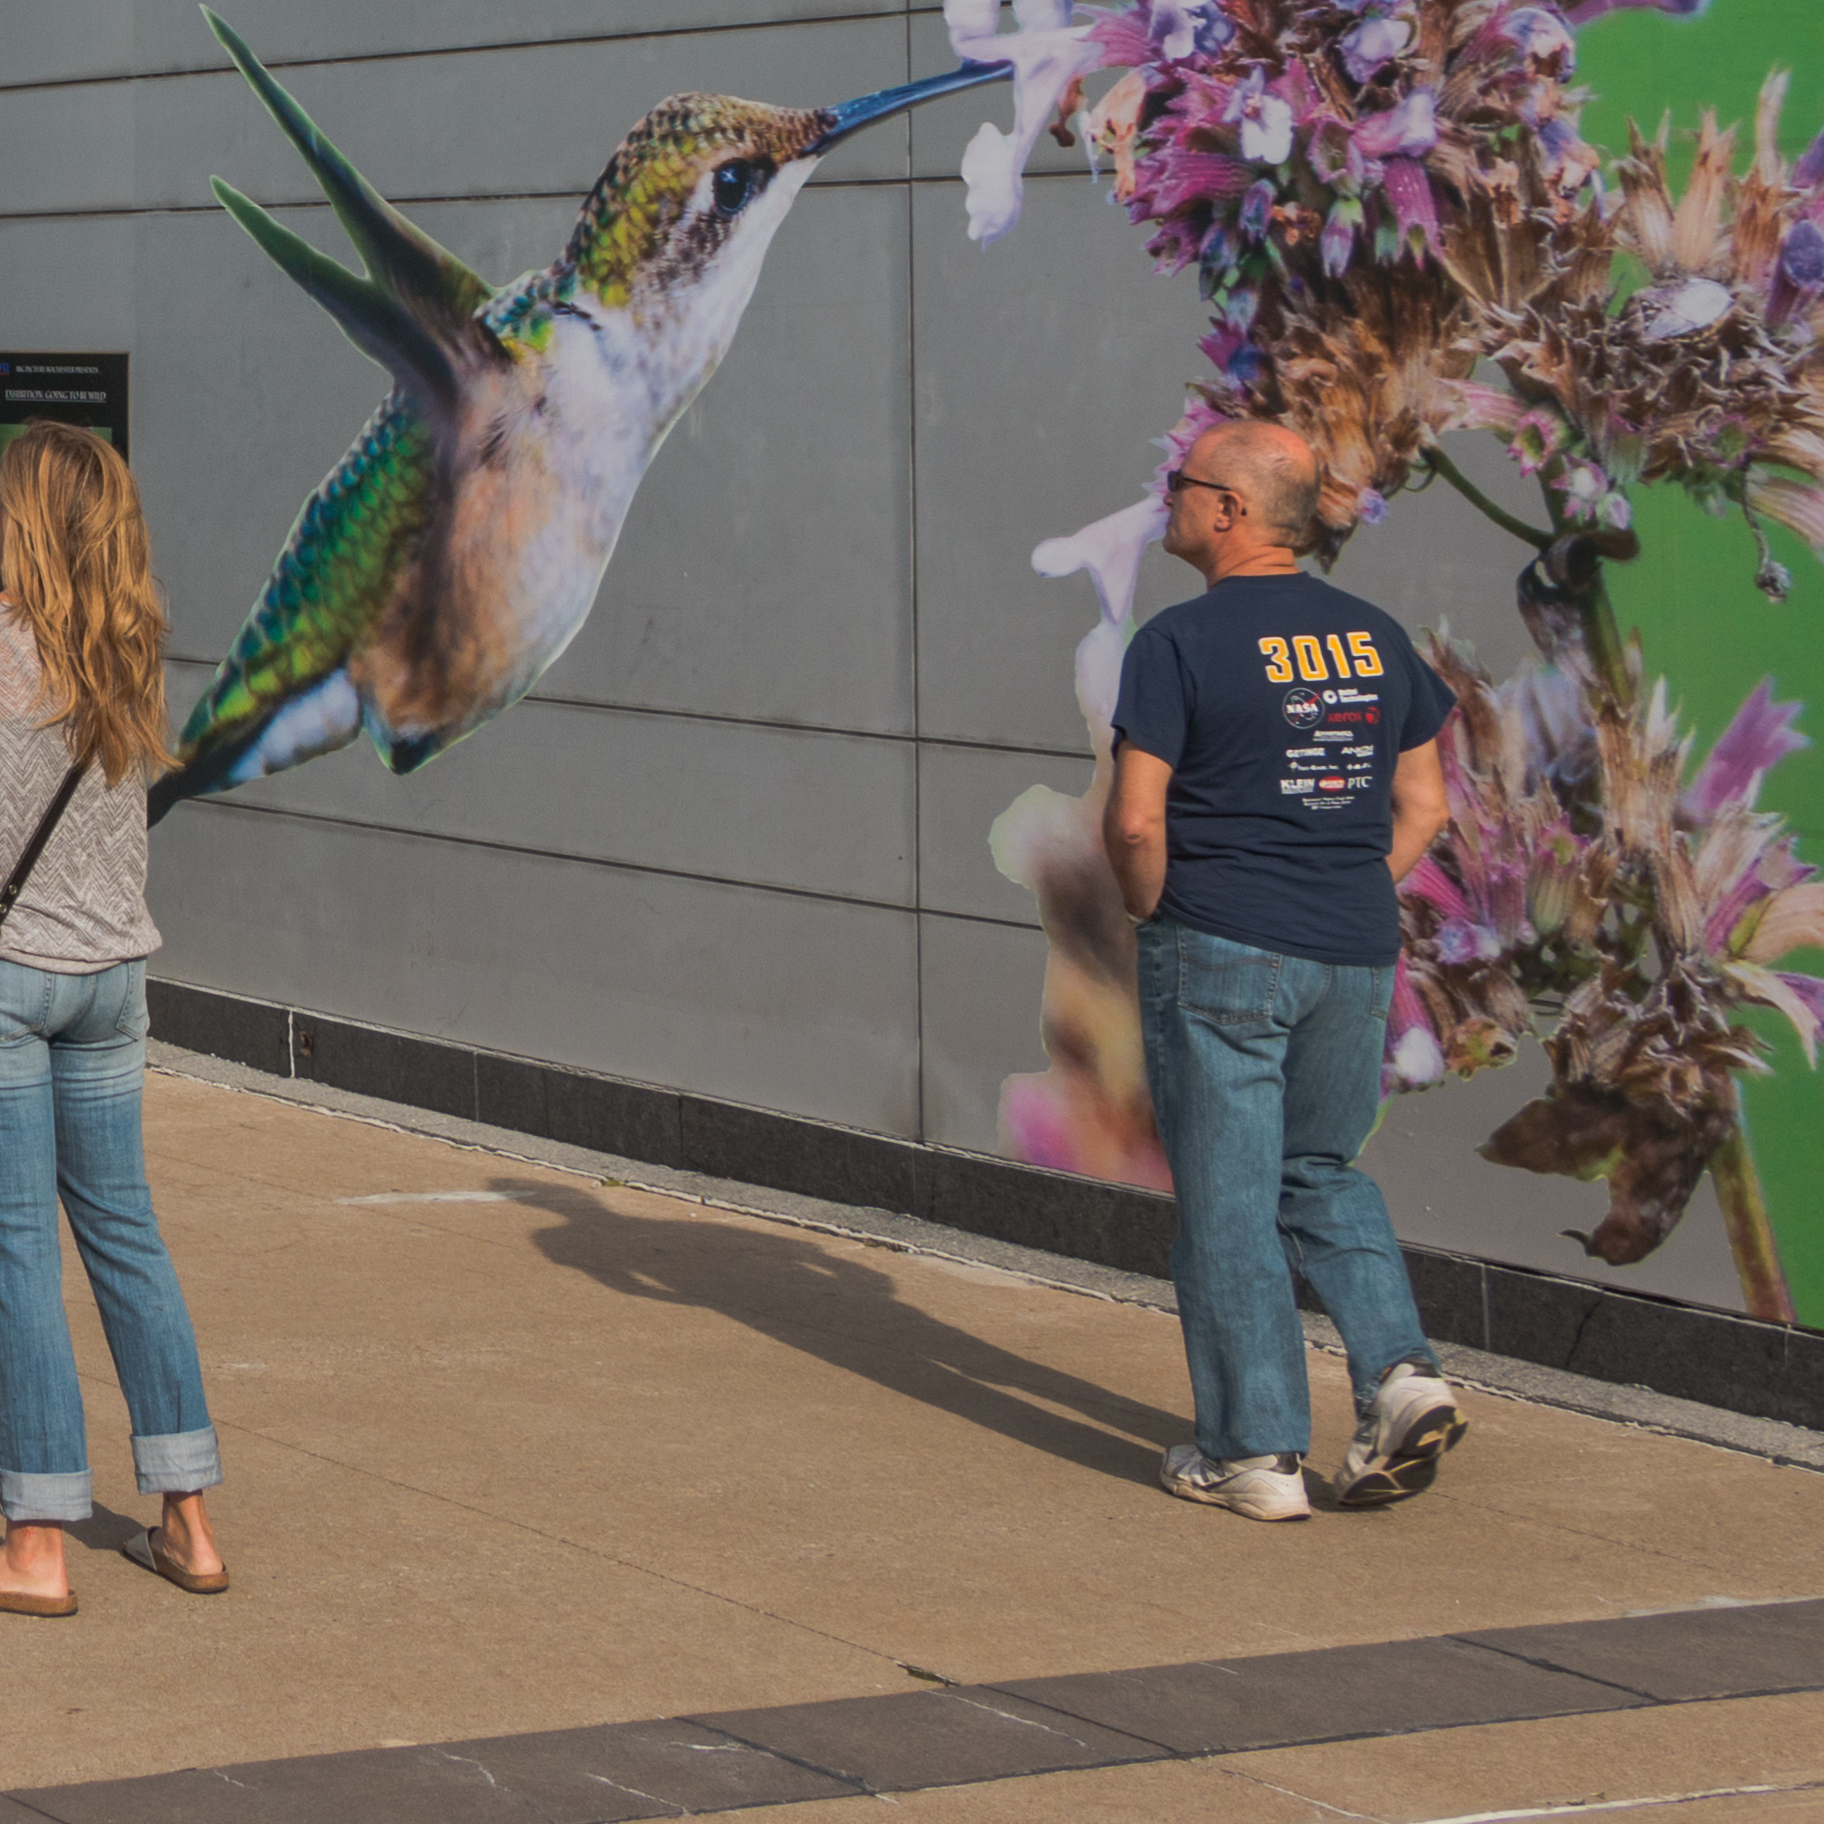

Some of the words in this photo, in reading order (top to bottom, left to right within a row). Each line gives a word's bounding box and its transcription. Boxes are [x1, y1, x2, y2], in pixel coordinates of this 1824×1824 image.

[1258, 631, 1384, 683] 3015
[1285, 704, 1319, 714] NASA
[1327, 711, 1362, 723] xerox
[1280, 779, 1315, 788] KLEIN
[1347, 777, 1373, 789] PTC
